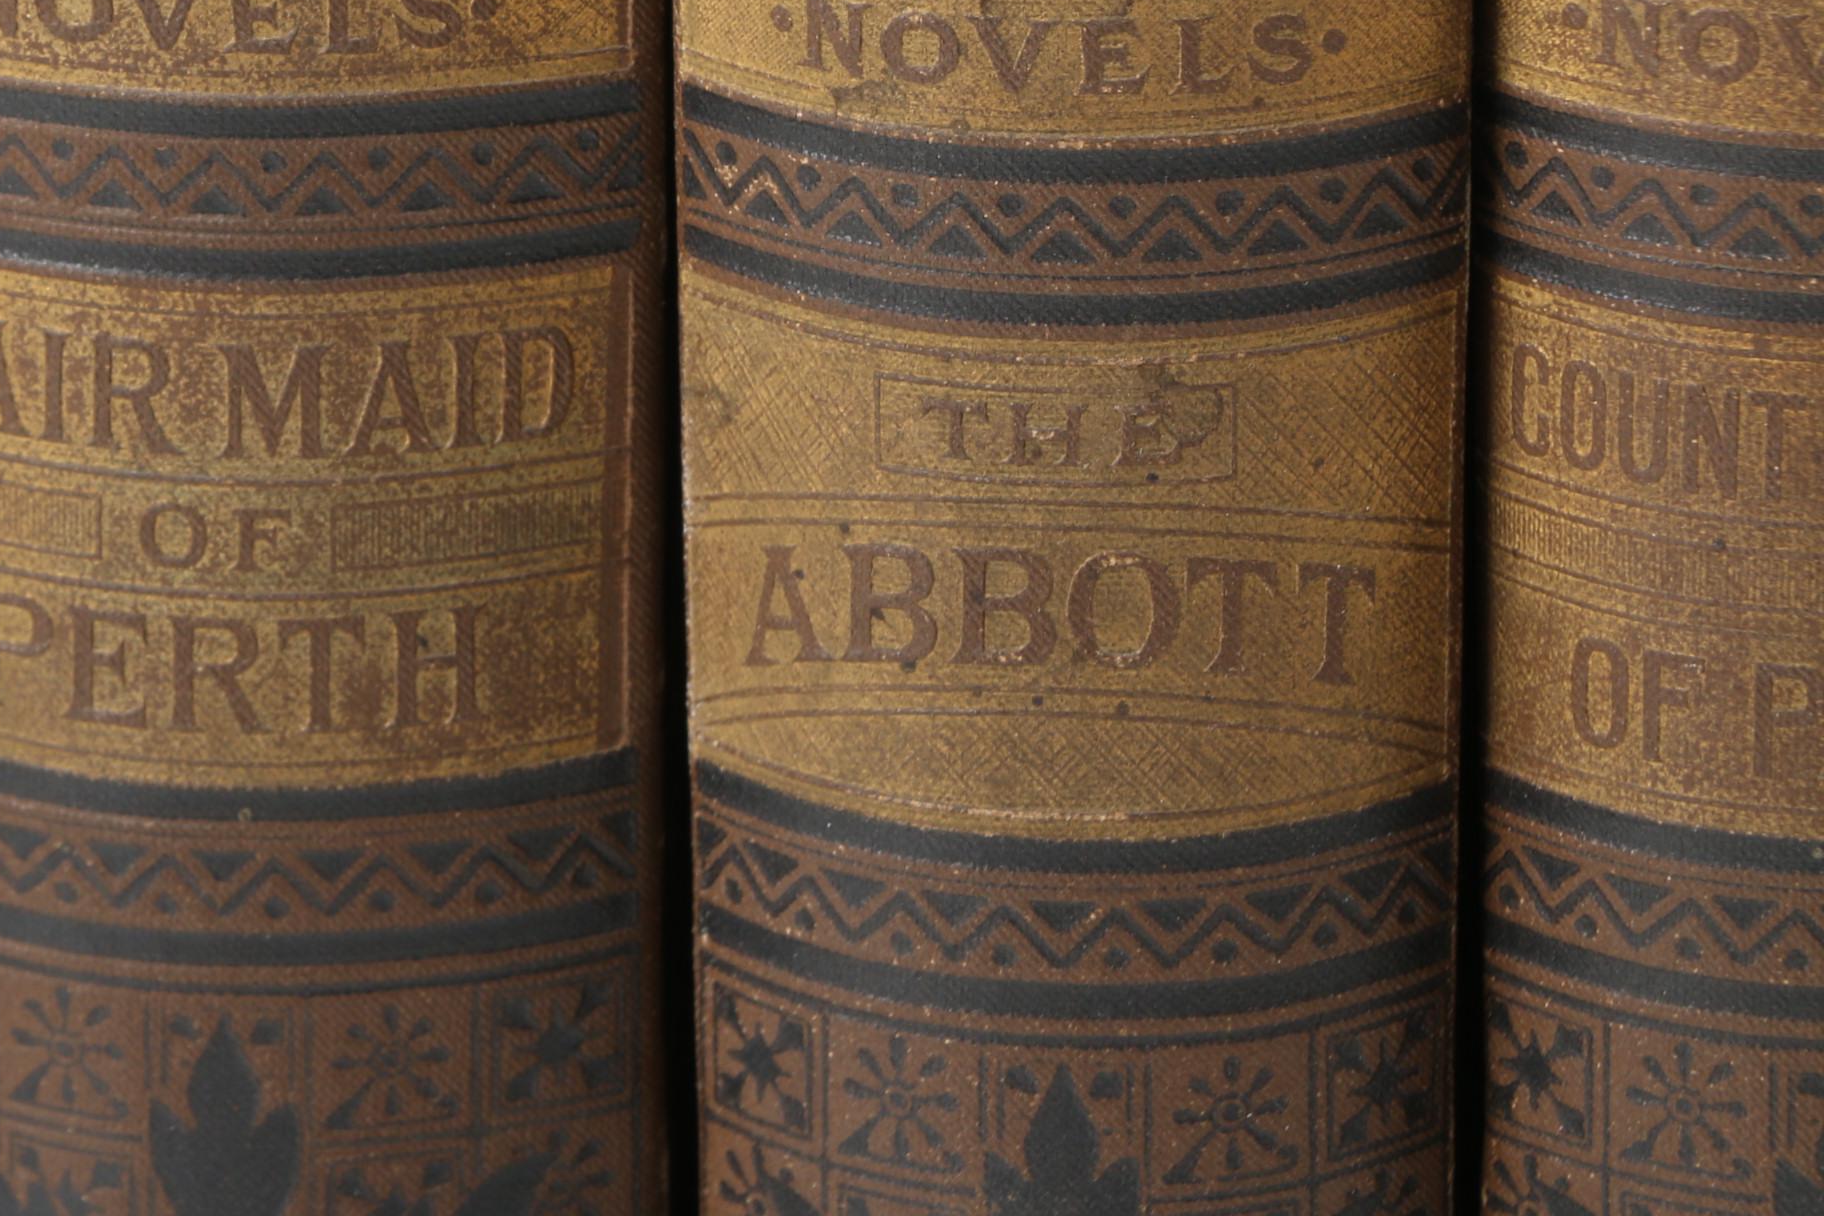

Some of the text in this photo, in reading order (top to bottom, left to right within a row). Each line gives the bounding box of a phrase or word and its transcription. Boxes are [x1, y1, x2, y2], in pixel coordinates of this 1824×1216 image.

[216, 324, 572, 461] MAID
[921, 396, 1180, 468] THE
[1511, 342, 1814, 502] COUNT
[138, 502, 294, 573] OF
[742, 542, 1378, 686] ABBOTT
[1573, 636, 1707, 765] OF
